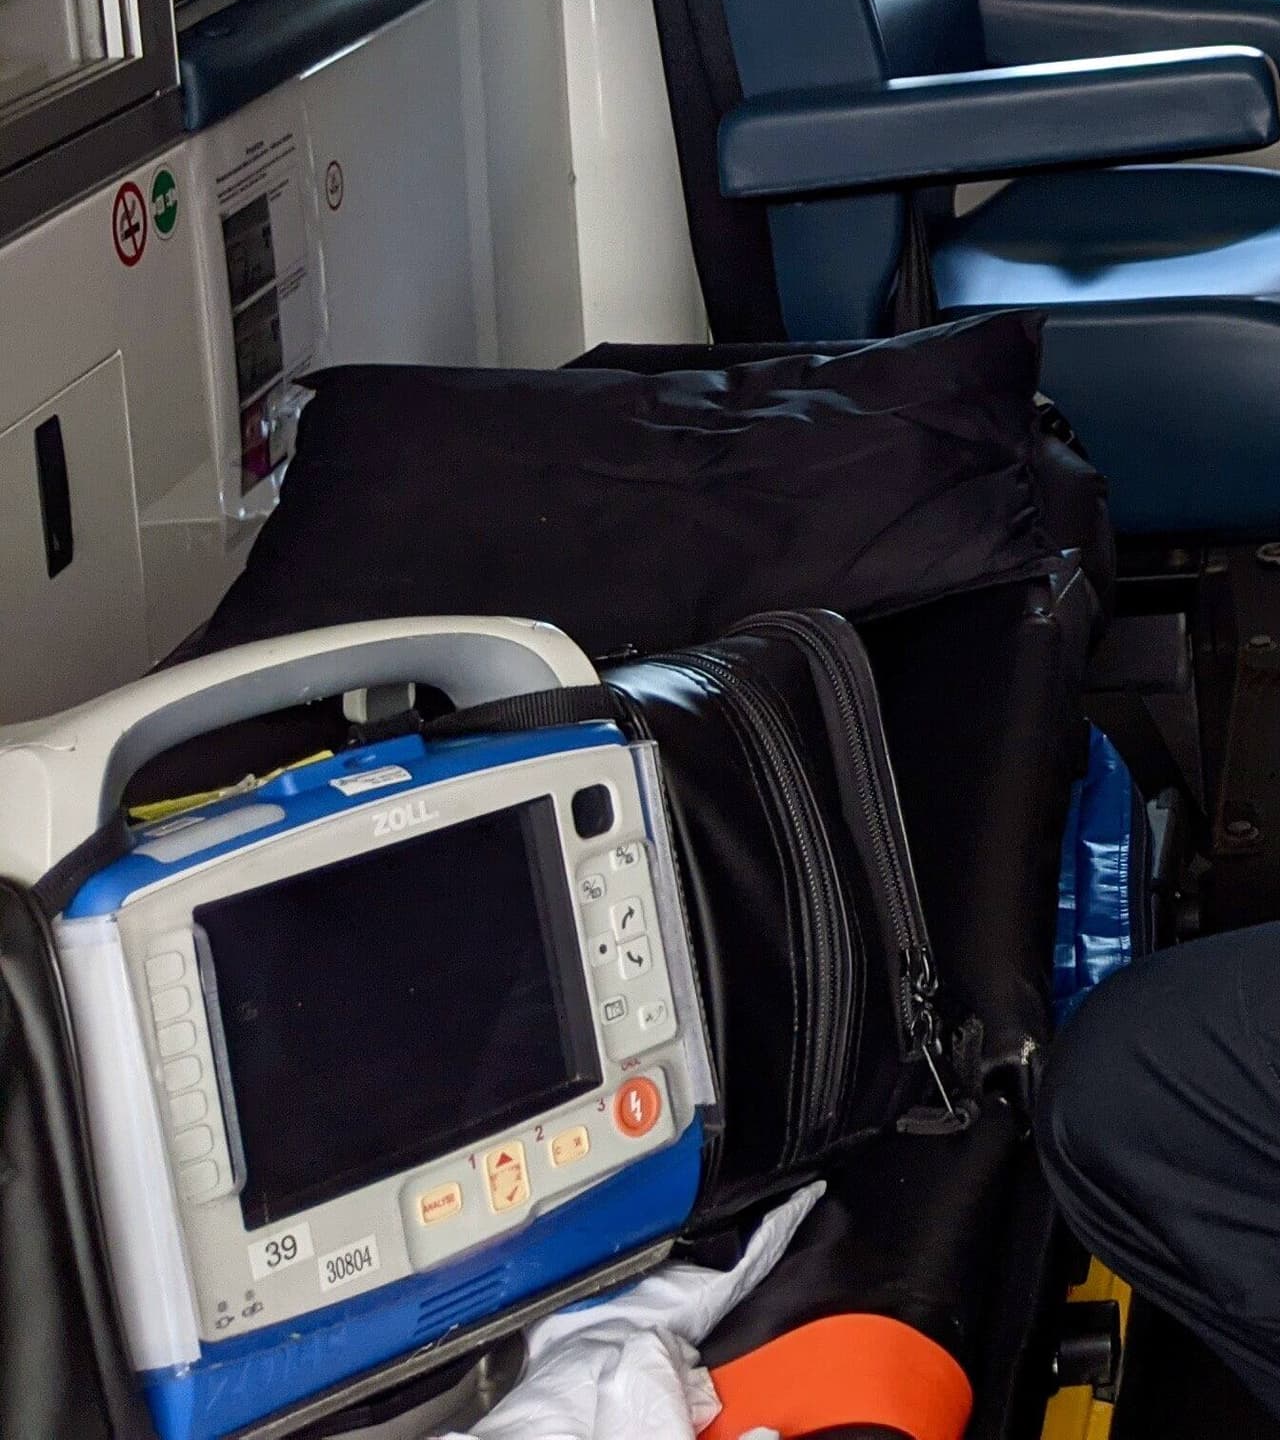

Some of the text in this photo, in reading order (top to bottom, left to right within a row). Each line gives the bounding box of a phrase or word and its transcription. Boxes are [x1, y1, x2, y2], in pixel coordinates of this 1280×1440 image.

[371, 800, 434, 837] ZOLL
[596, 1097, 606, 1112] 3
[534, 1125, 545, 1142] 2
[468, 1153, 477, 1170] 1
[265, 1234, 298, 1268] 39
[326, 1245, 373, 1284] 30804
